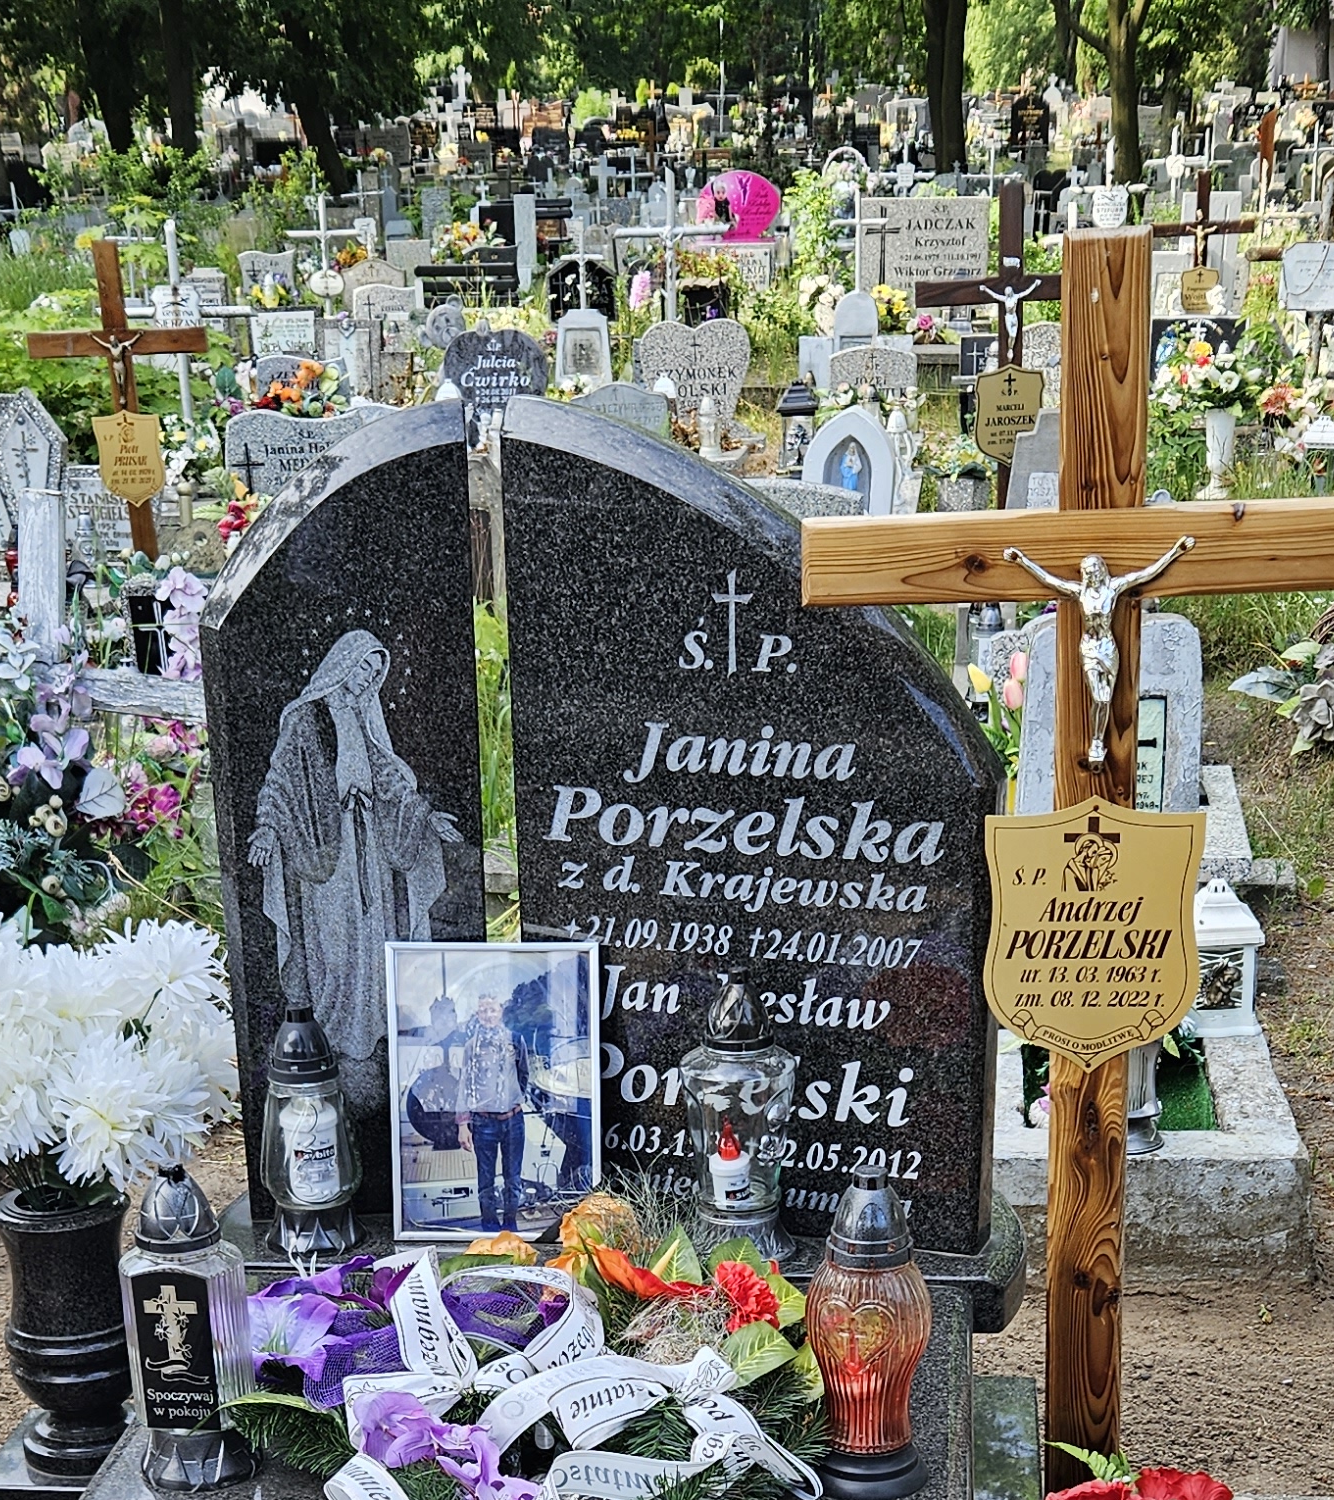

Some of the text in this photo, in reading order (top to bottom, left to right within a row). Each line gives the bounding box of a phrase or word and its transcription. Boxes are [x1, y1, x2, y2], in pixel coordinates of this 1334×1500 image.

[904, 217, 976, 232] JADCZAK
[914, 235, 968, 249] Krzysztof
[893, 265, 931, 277] Wiktor
[473, 355, 517, 370] Julcia
[460, 366, 531, 387] Ćwirko
[677, 383, 727, 398] OLSKI
[996, 403, 1025, 412] MARCELI
[985, 415, 1036, 428] JAROSZEK
[265, 444, 305, 457] Janina
[114, 456, 148, 467] PRUSAK
[679, 616, 798, 674] Ś. P.
[622, 721, 857, 784] Janina
[542, 784, 946, 867] Porzelska
[557, 855, 928, 912] z d. Krajewska
[1032, 867, 1047, 886] P.
[1039, 896, 1144, 927] Andrzej
[1005, 929, 1173, 960] PORZELSKI
[1020, 966, 1162, 983] ur. 13. 03. 1963 r.
[602, 963, 682, 1020] Jan
[1014, 990, 1165, 1008] zm. 08. 12. 2022 r.
[1041, 1028, 1071, 1048] PROSI
[146, 1388, 214, 1405] Spoczywaj
[153, 1404, 211, 1421] w pokoju
